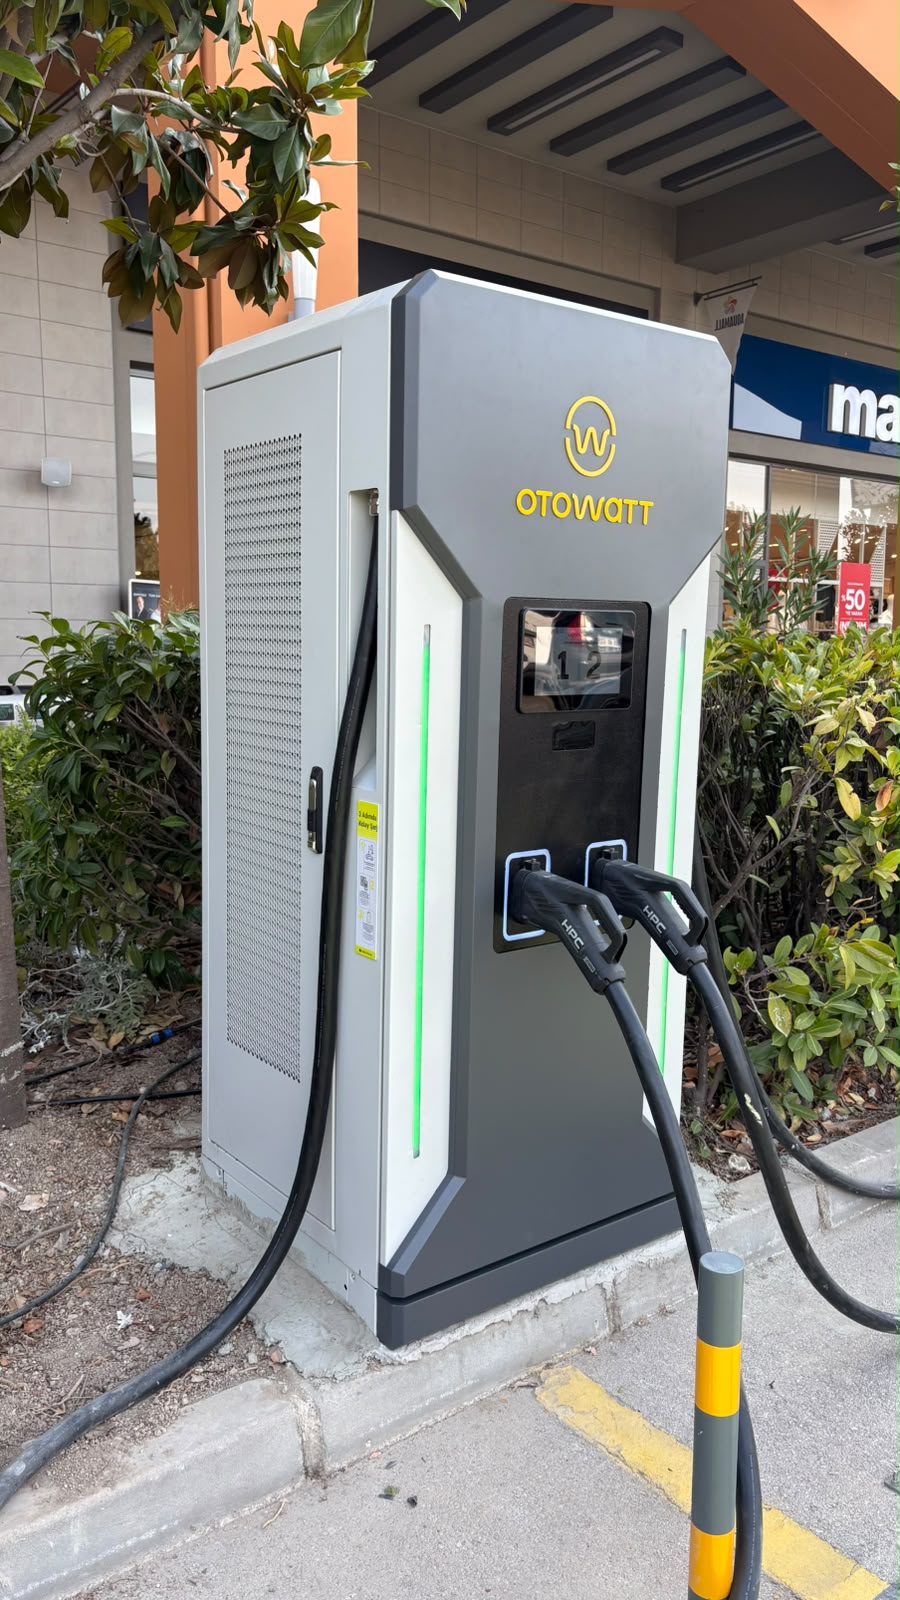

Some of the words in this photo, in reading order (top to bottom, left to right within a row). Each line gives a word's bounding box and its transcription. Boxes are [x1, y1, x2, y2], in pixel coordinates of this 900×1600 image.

[558, 651, 569, 679] 1
[586, 651, 602, 679] 2
[643, 905, 666, 934] HPC
[561, 919, 584, 950] HPC
